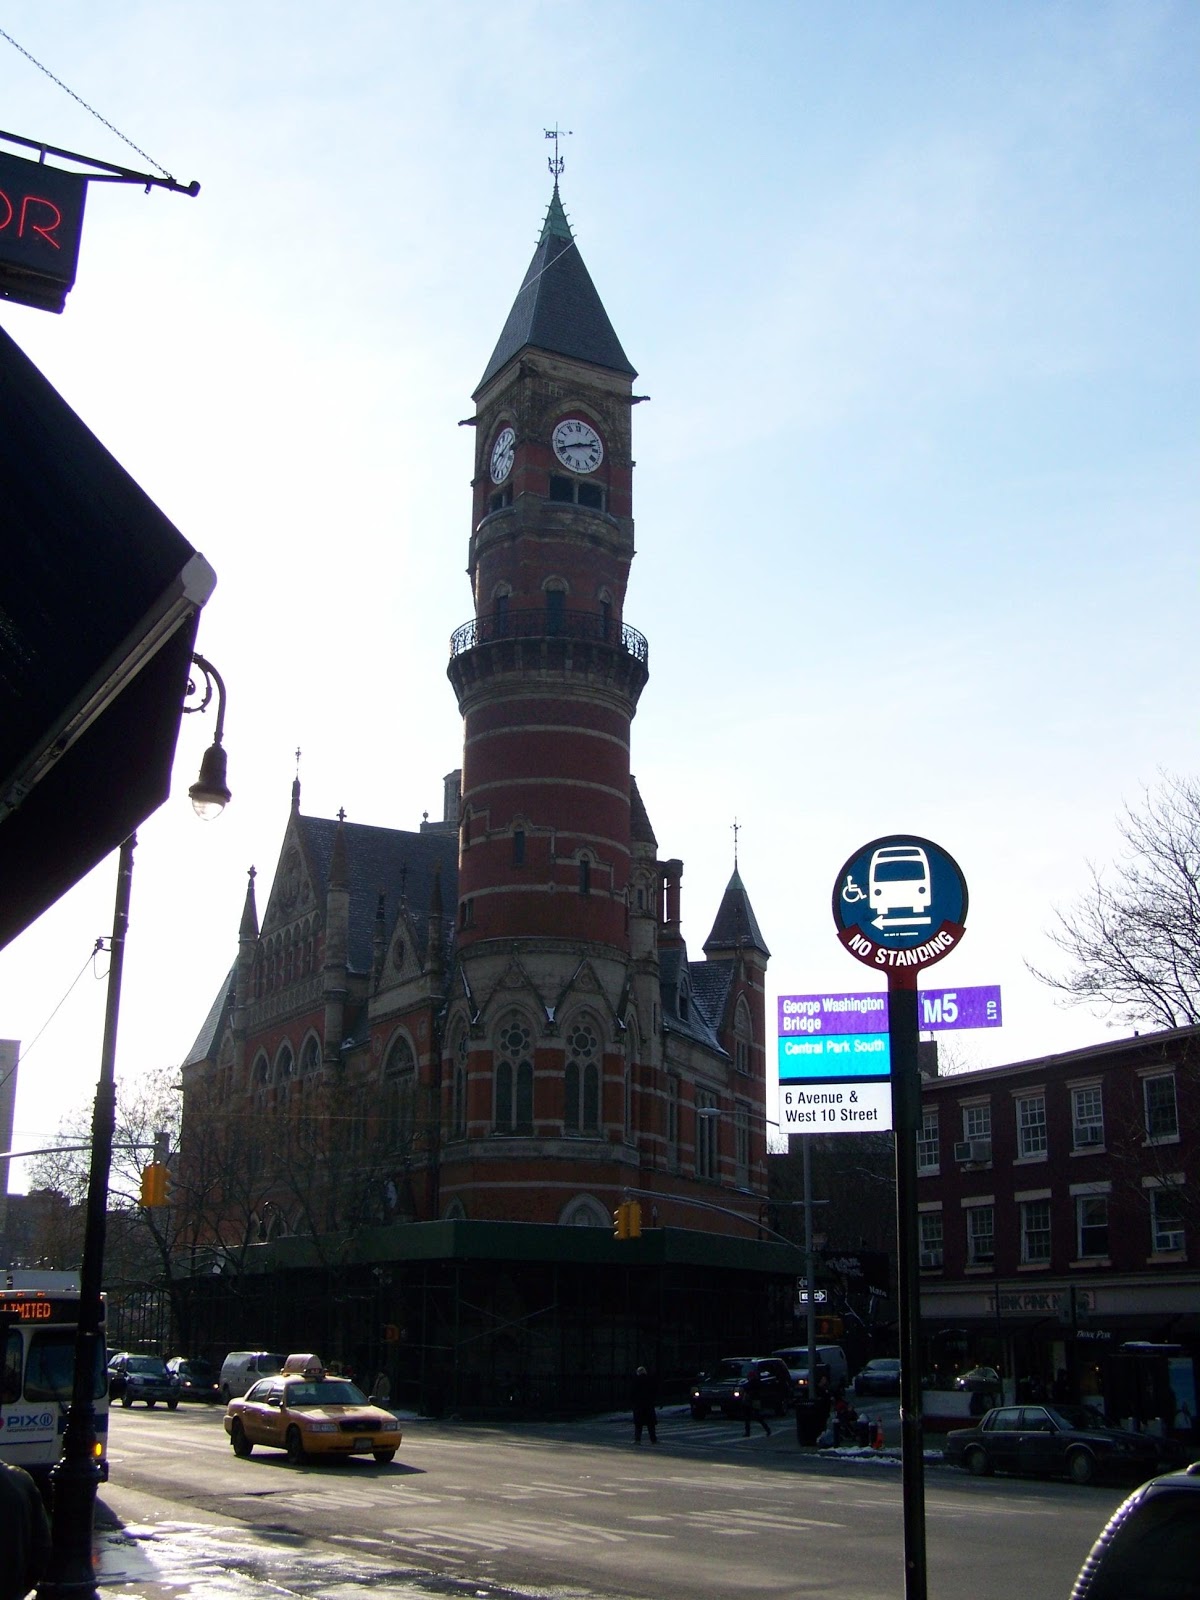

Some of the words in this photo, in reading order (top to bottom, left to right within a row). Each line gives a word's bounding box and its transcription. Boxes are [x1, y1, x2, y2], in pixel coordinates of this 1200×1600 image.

[848, 933, 873, 957] NO
[875, 931, 954, 966] STANDING
[783, 999, 820, 1015] George
[822, 997, 884, 1013] Washington
[923, 993, 958, 1023] M5
[986, 1001, 997, 1019] LTD
[783, 1016, 821, 1032] Bridge
[784, 1041, 823, 1055] Central
[826, 1040, 851, 1053] Park
[853, 1039, 885, 1052] South
[785, 1092, 792, 1104] 6
[798, 1091, 843, 1104] Avenue
[849, 1090, 858, 1102] &
[785, 1109, 816, 1122] West
[821, 1109, 836, 1121] 10
[840, 1108, 878, 1121] Street
[7, 1415, 39, 1426] PIX
